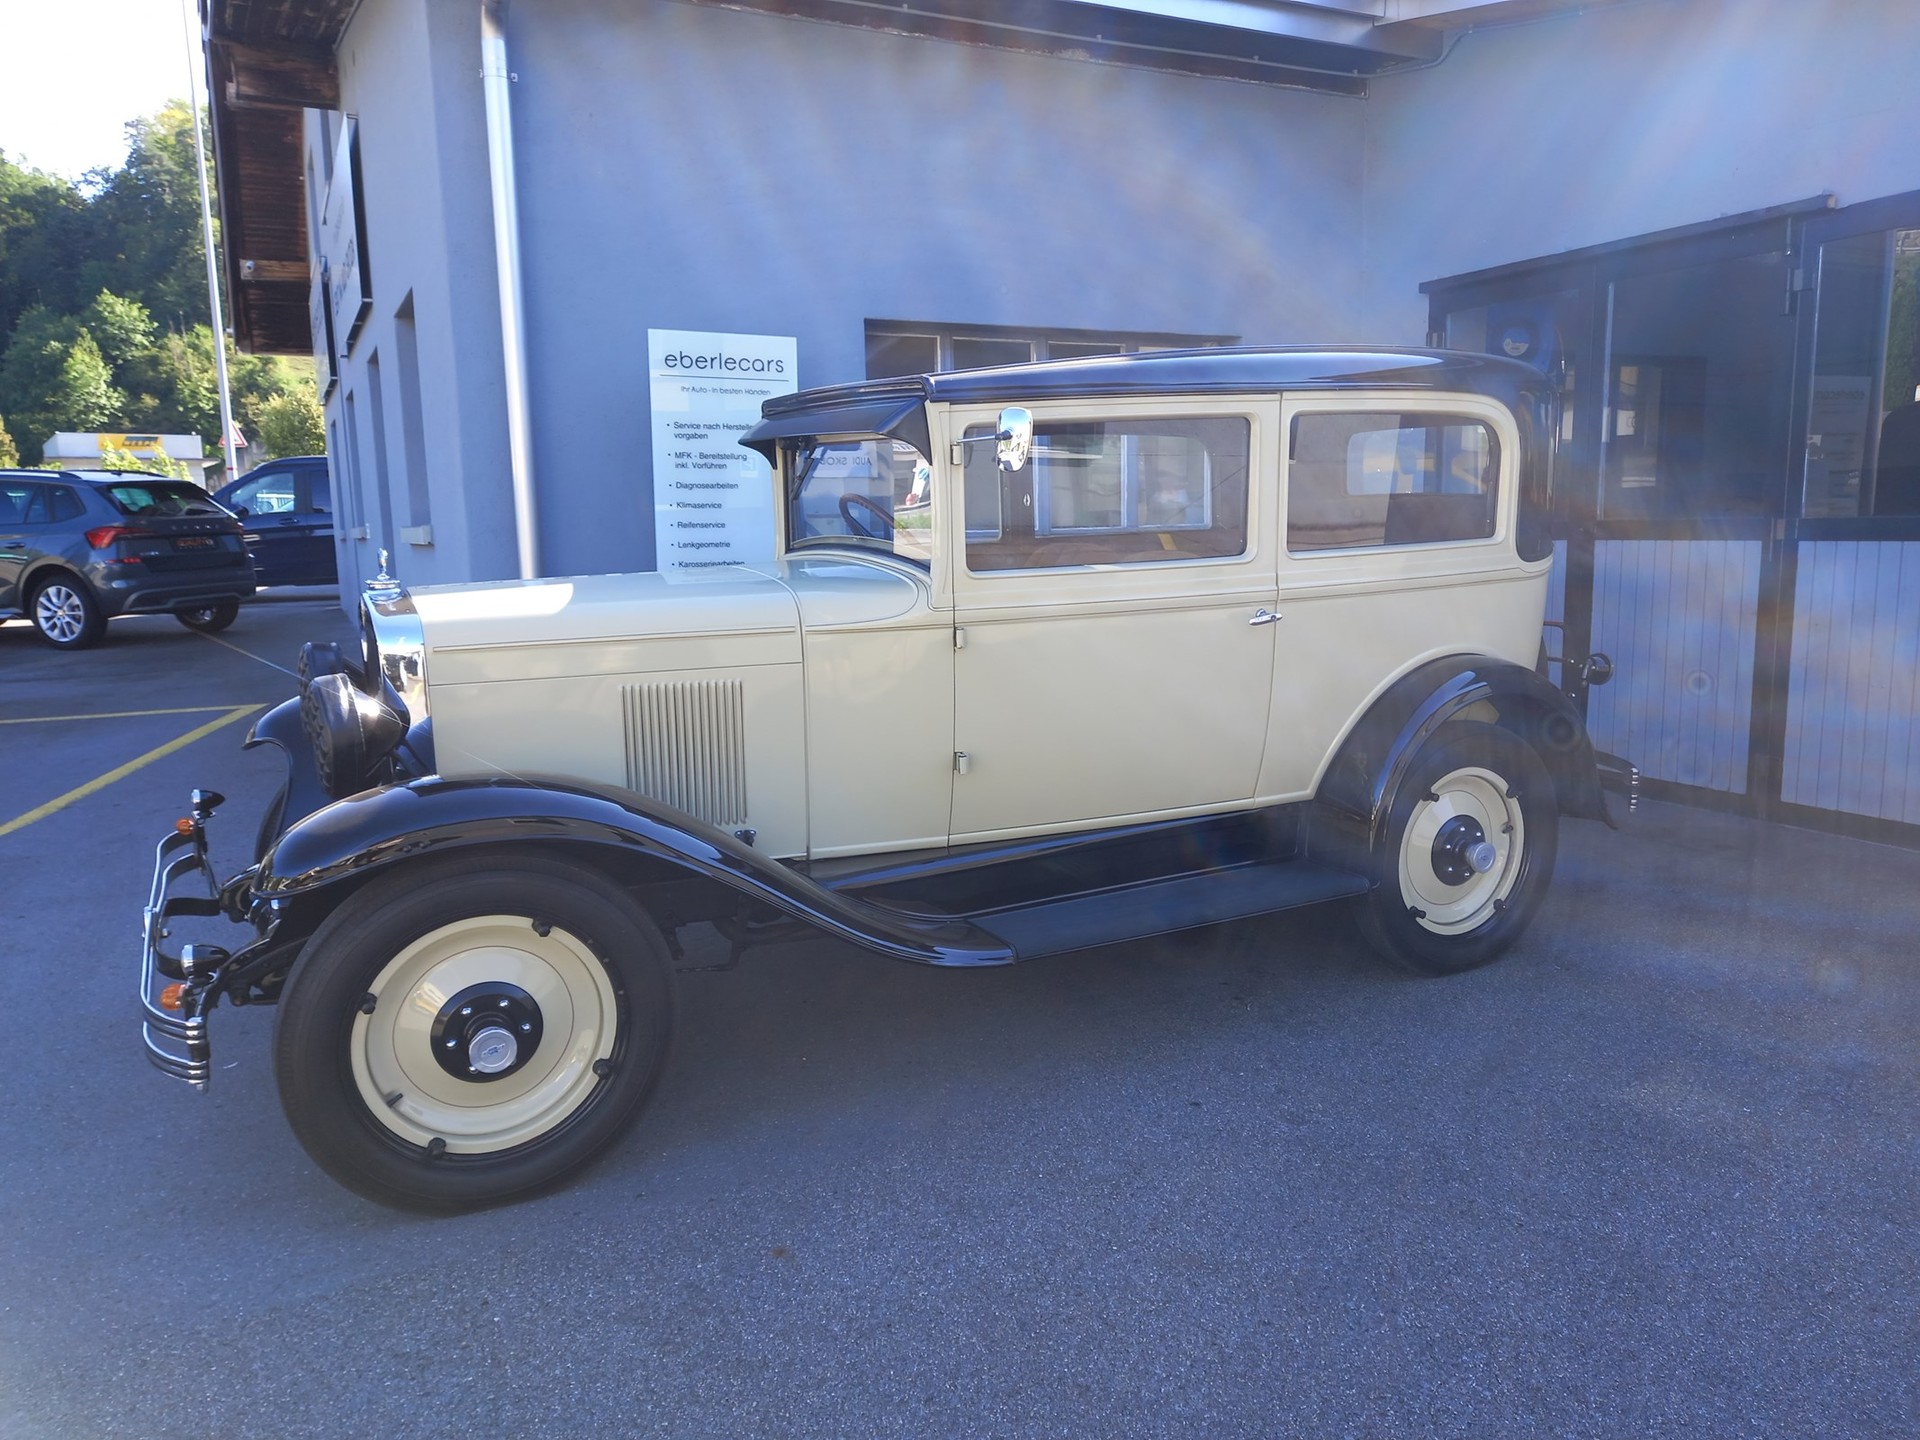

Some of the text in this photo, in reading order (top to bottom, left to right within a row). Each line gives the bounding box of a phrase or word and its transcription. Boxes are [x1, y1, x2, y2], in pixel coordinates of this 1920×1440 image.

[664, 350, 785, 373] eberlecars
[691, 386, 708, 394] Auto
[720, 387, 743, 395] besten
[673, 422, 701, 430] Service
[702, 422, 721, 431] nach
[673, 432, 709, 441] vorgaben
[674, 452, 693, 460] MFK
[699, 452, 748, 461] Bereitstellung
[692, 462, 728, 470] Vorführen
[675, 481, 739, 491] Diagnosearbeiten
[676, 501, 723, 510] Klimaservice
[676, 521, 727, 529] Reifenservice
[677, 541, 731, 550] Lenkgeometrie
